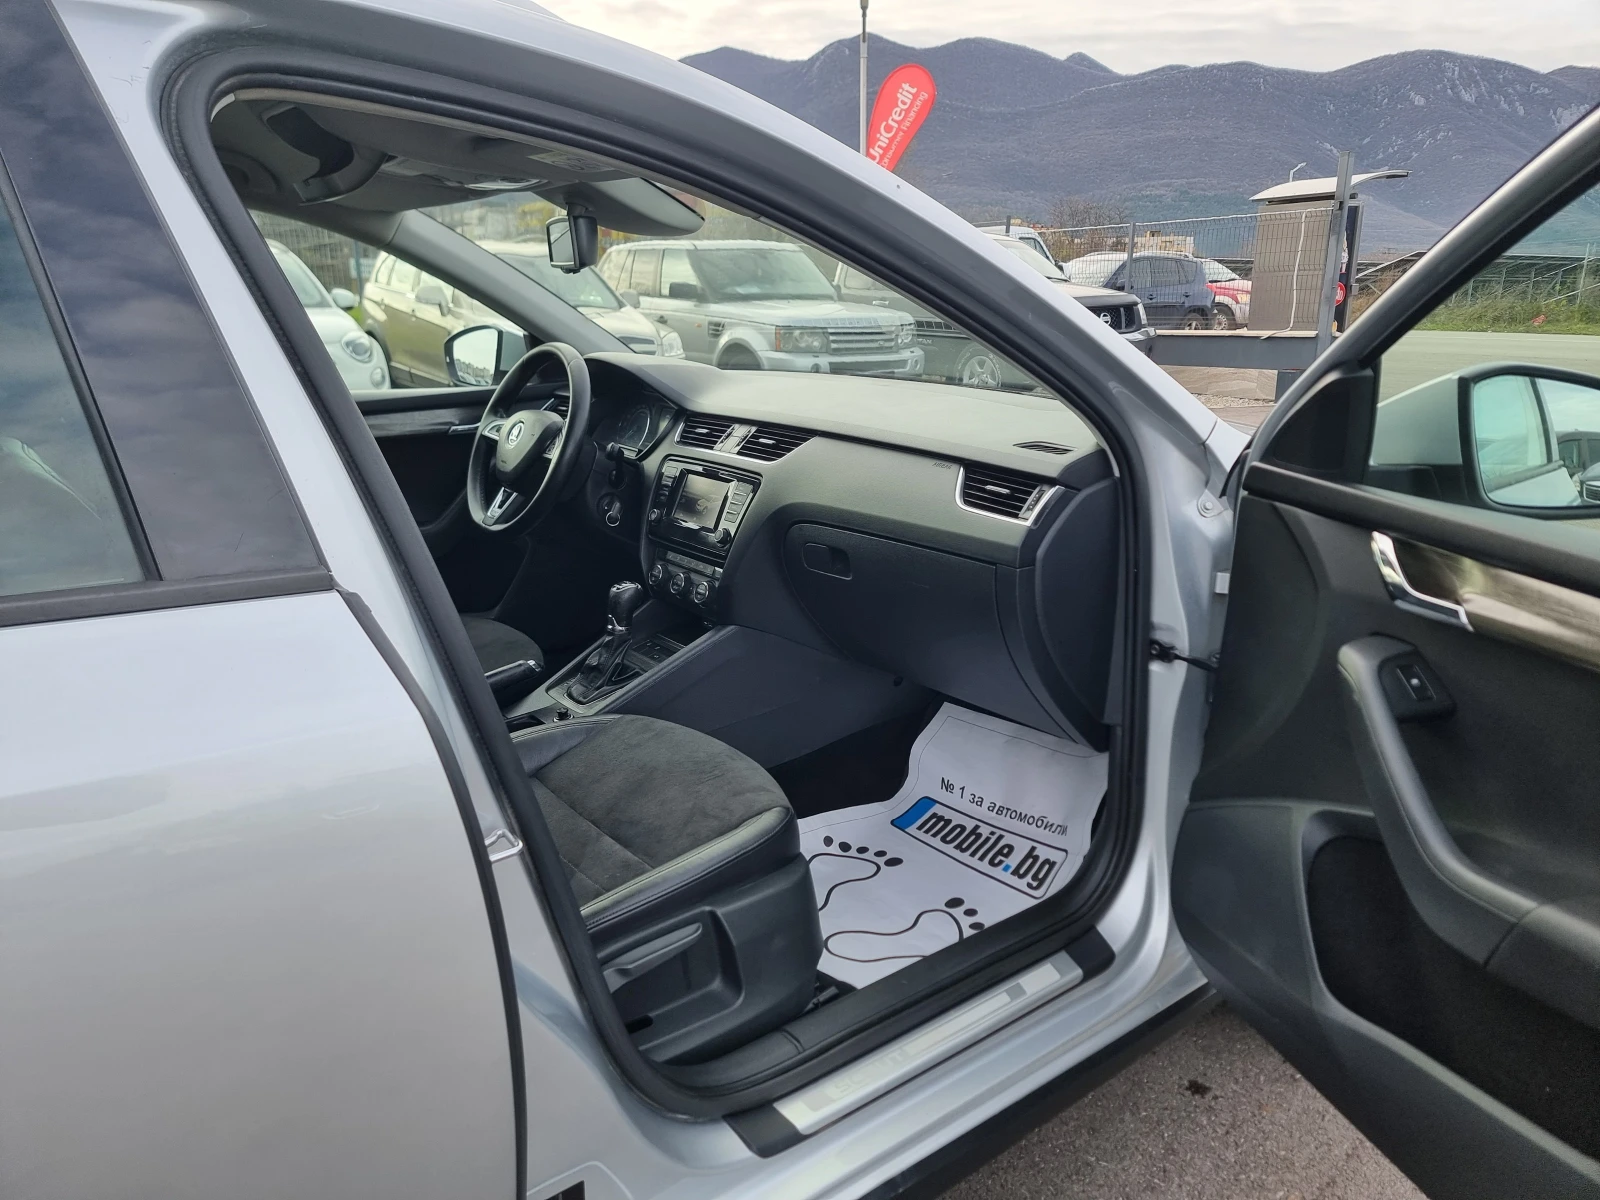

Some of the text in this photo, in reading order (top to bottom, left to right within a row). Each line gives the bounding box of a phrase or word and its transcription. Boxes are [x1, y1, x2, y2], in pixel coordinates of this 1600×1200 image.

[868, 83, 917, 163] UniCredit
[901, 91, 928, 130] Financing
[959, 785, 966, 800] 1
[968, 793, 984, 808] за
[987, 801, 1068, 836] автомобили
[916, 812, 1057, 891] mobile.bg
